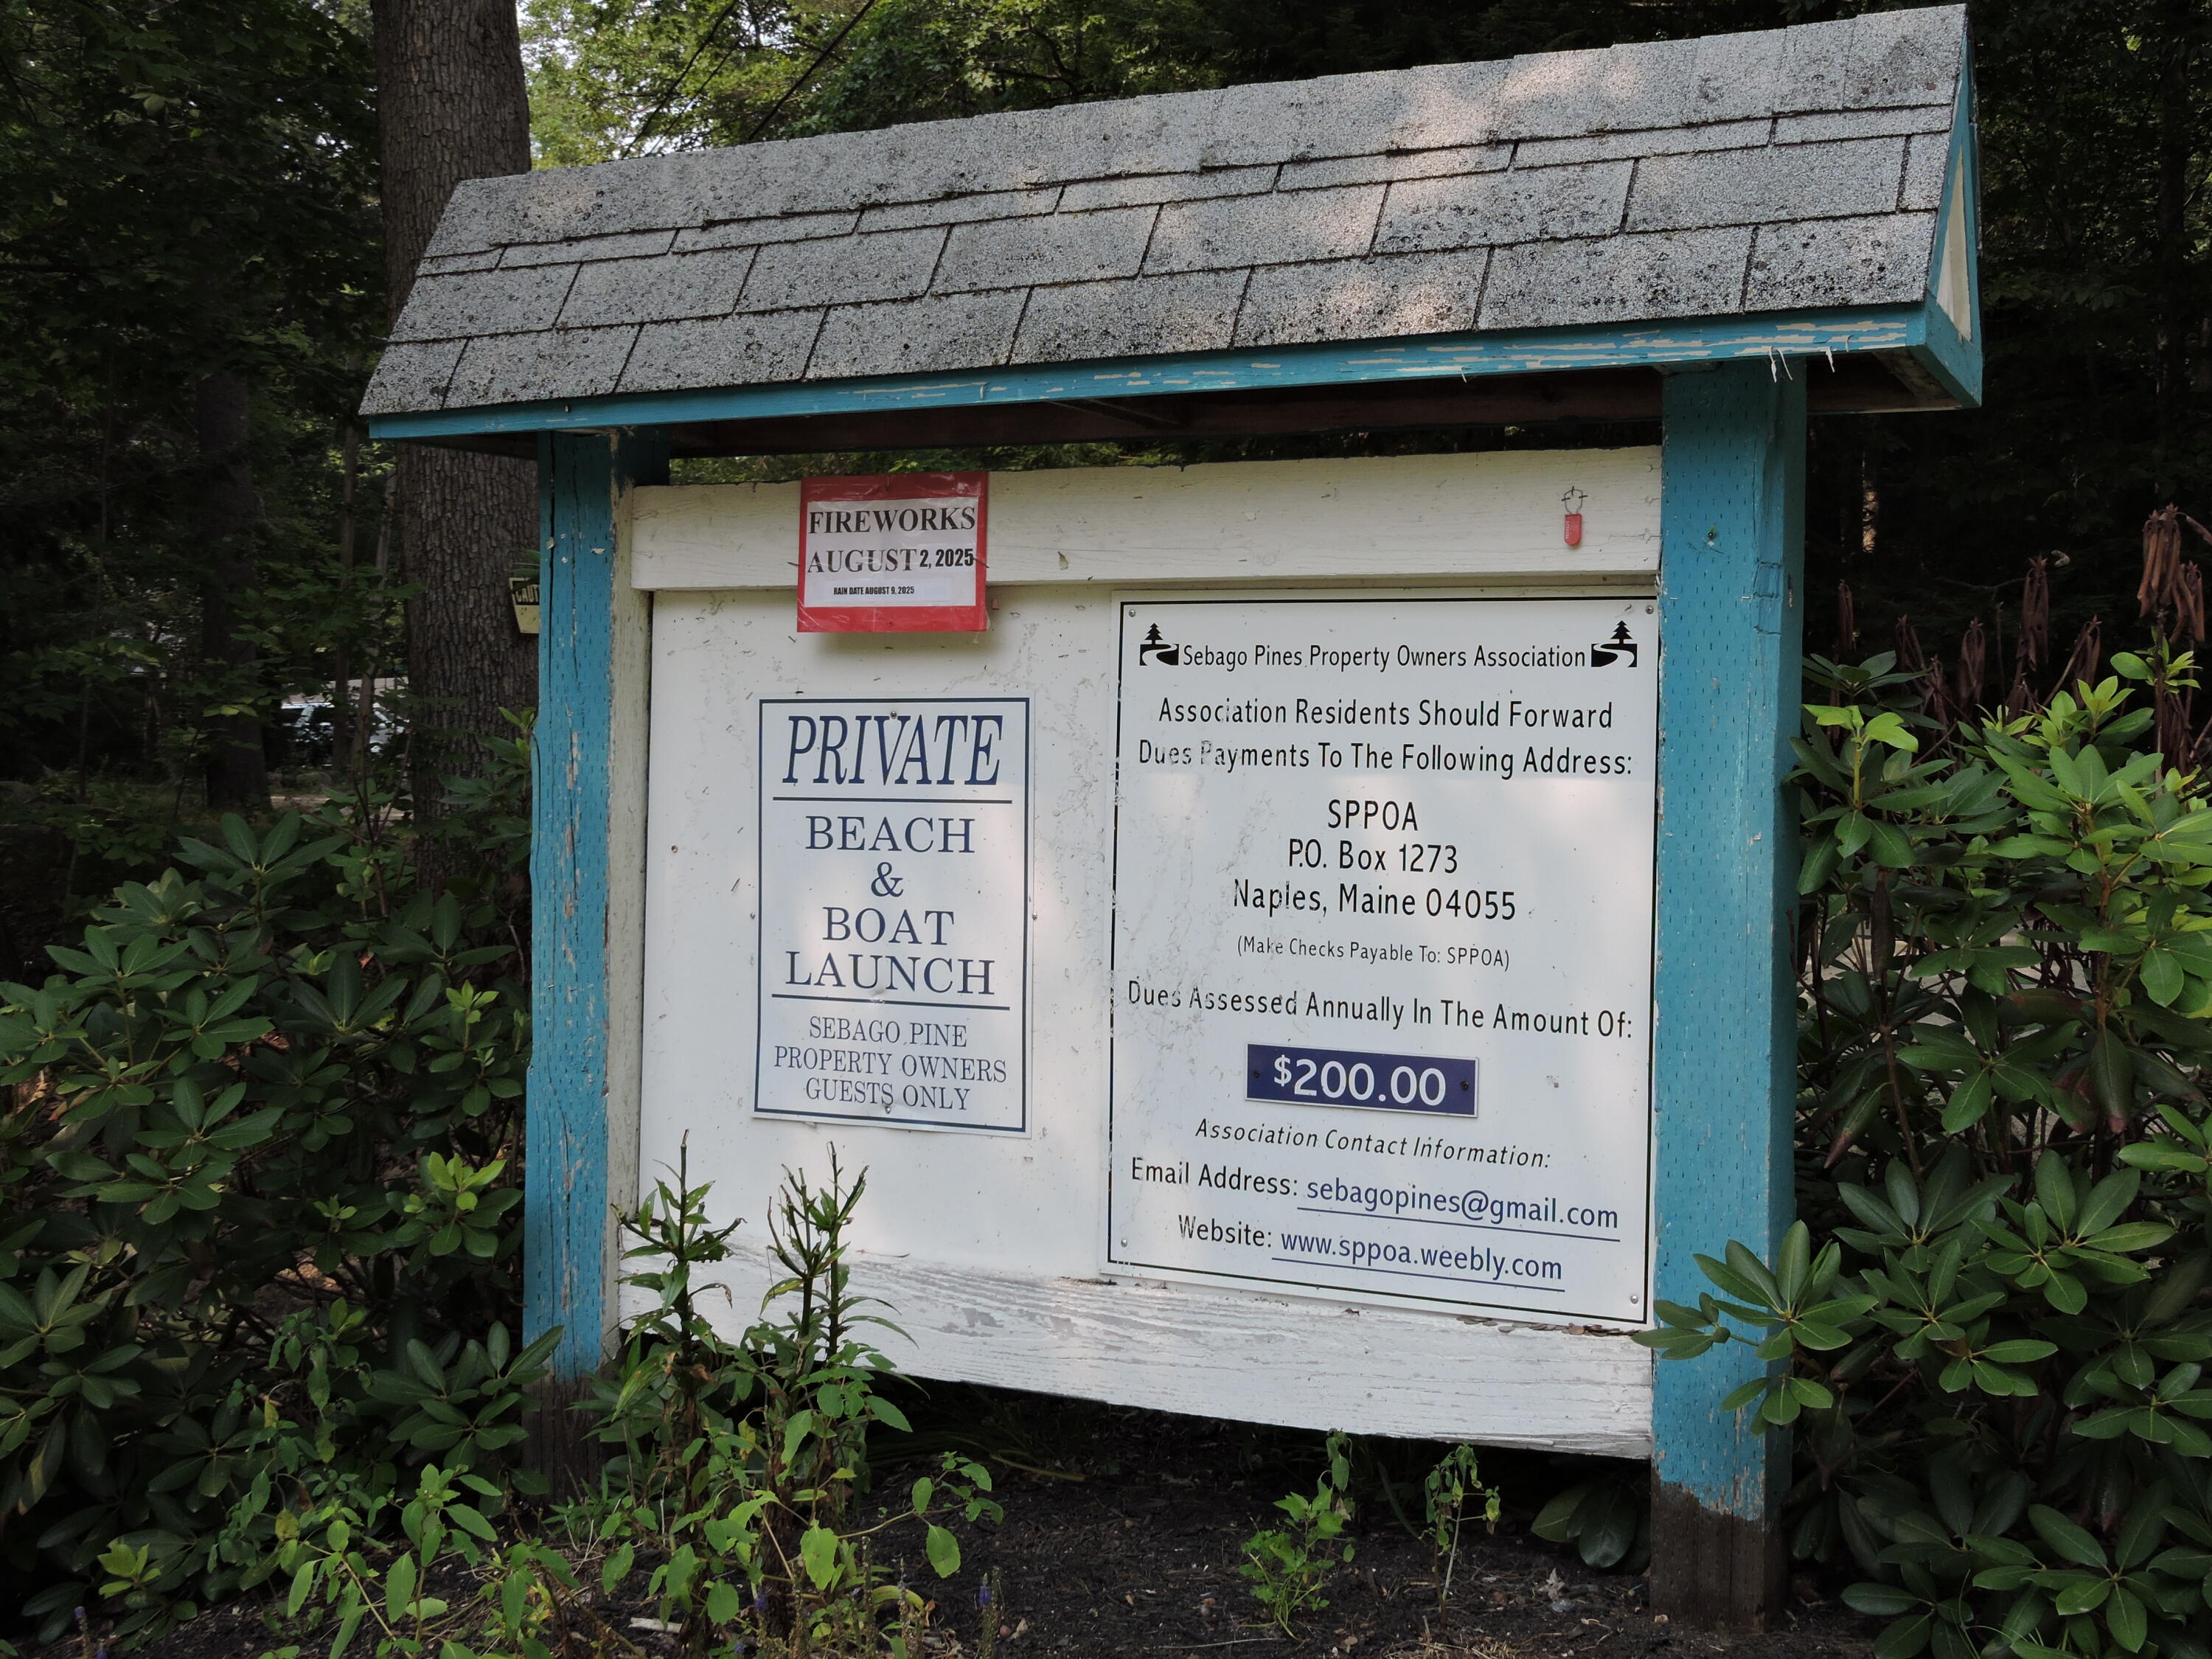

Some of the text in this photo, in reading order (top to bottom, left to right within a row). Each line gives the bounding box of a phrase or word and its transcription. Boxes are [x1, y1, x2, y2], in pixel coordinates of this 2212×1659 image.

[808, 507, 975, 534] FIREWORKS
[807, 548, 974, 574] AUGUST 2, 2025
[515, 584, 539, 602] CAUT
[833, 586, 914, 596] RAIN DATE AUGUST 9, 2025
[1183, 644, 1585, 672] Sebago Pines Property Owners Association
[1159, 697, 1613, 728] Association Residents Should Forward
[782, 714, 1004, 786] PRIVATE
[1139, 739, 1632, 780] Dues Payments To The Following Address:
[1327, 799, 1418, 831] SPPOA
[805, 815, 975, 853] BEACH
[1289, 838, 1458, 874] P.O. Box 1273
[870, 861, 904, 897] &
[1234, 878, 1516, 920] Naples, Maine 04055
[822, 906, 954, 945] BOAT
[1237, 935, 1509, 972] (Make Checks Payable To: SPPOA)
[785, 950, 995, 995] LAUNCH
[1128, 979, 1632, 1038] Dues Assessed Annually In The Amount Of:
[810, 1015, 967, 1048] SEBAGO PINE
[773, 1046, 1007, 1083] PROPERTY OWNERS
[1273, 1054, 1446, 1106] $200.00
[806, 1077, 970, 1110] GUESTS ONLY
[1195, 1118, 1551, 1168] Association Contact Information:
[1132, 1157, 1618, 1228] Email Address: sebagopines@gmail.com
[1178, 1214, 1562, 1280] Website: www.sppoa.weebly.com
